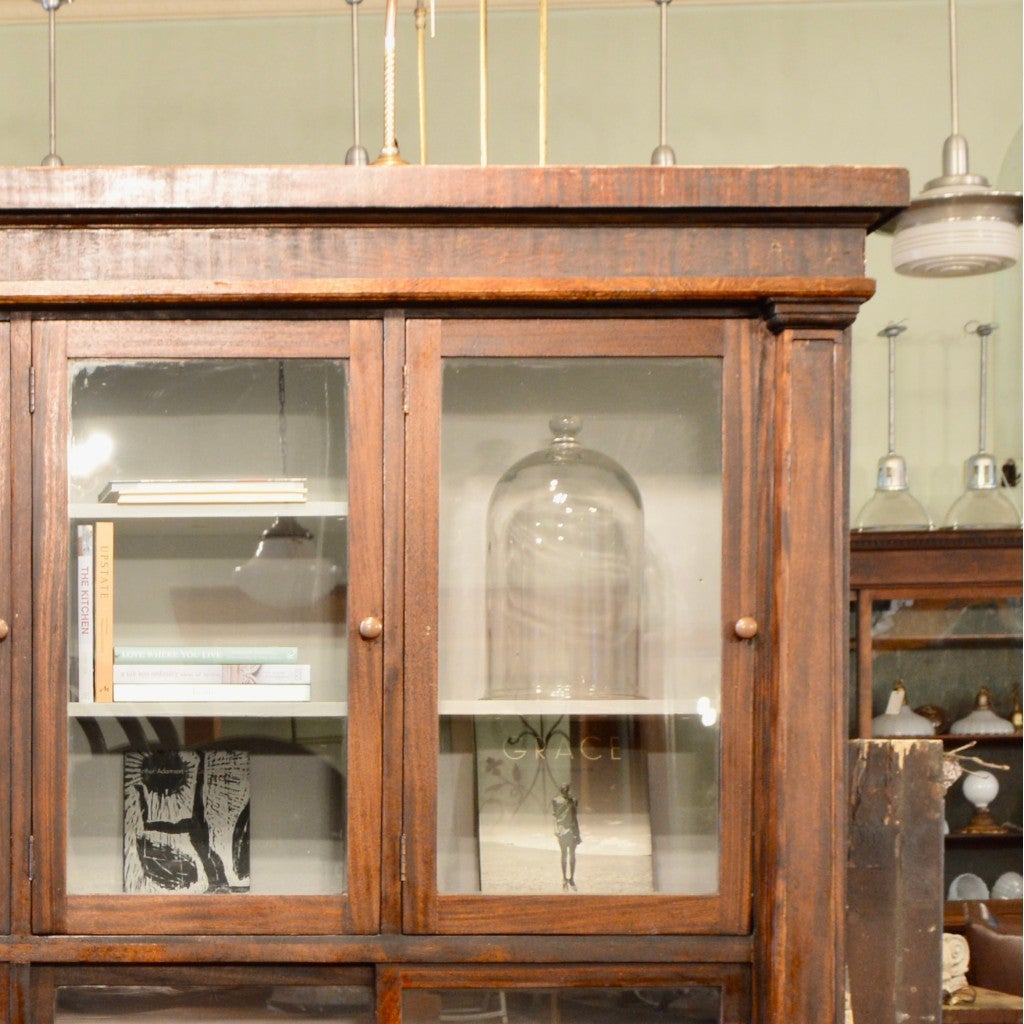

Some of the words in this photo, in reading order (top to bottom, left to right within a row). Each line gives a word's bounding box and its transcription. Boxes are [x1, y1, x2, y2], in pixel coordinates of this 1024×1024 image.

[81, 566, 89, 586] THE
[100, 545, 109, 599] UPSTATE
[81, 590, 89, 635] KITCHEN
[181, 650, 199, 658] YOU
[502, 736, 624, 761] GRACE
